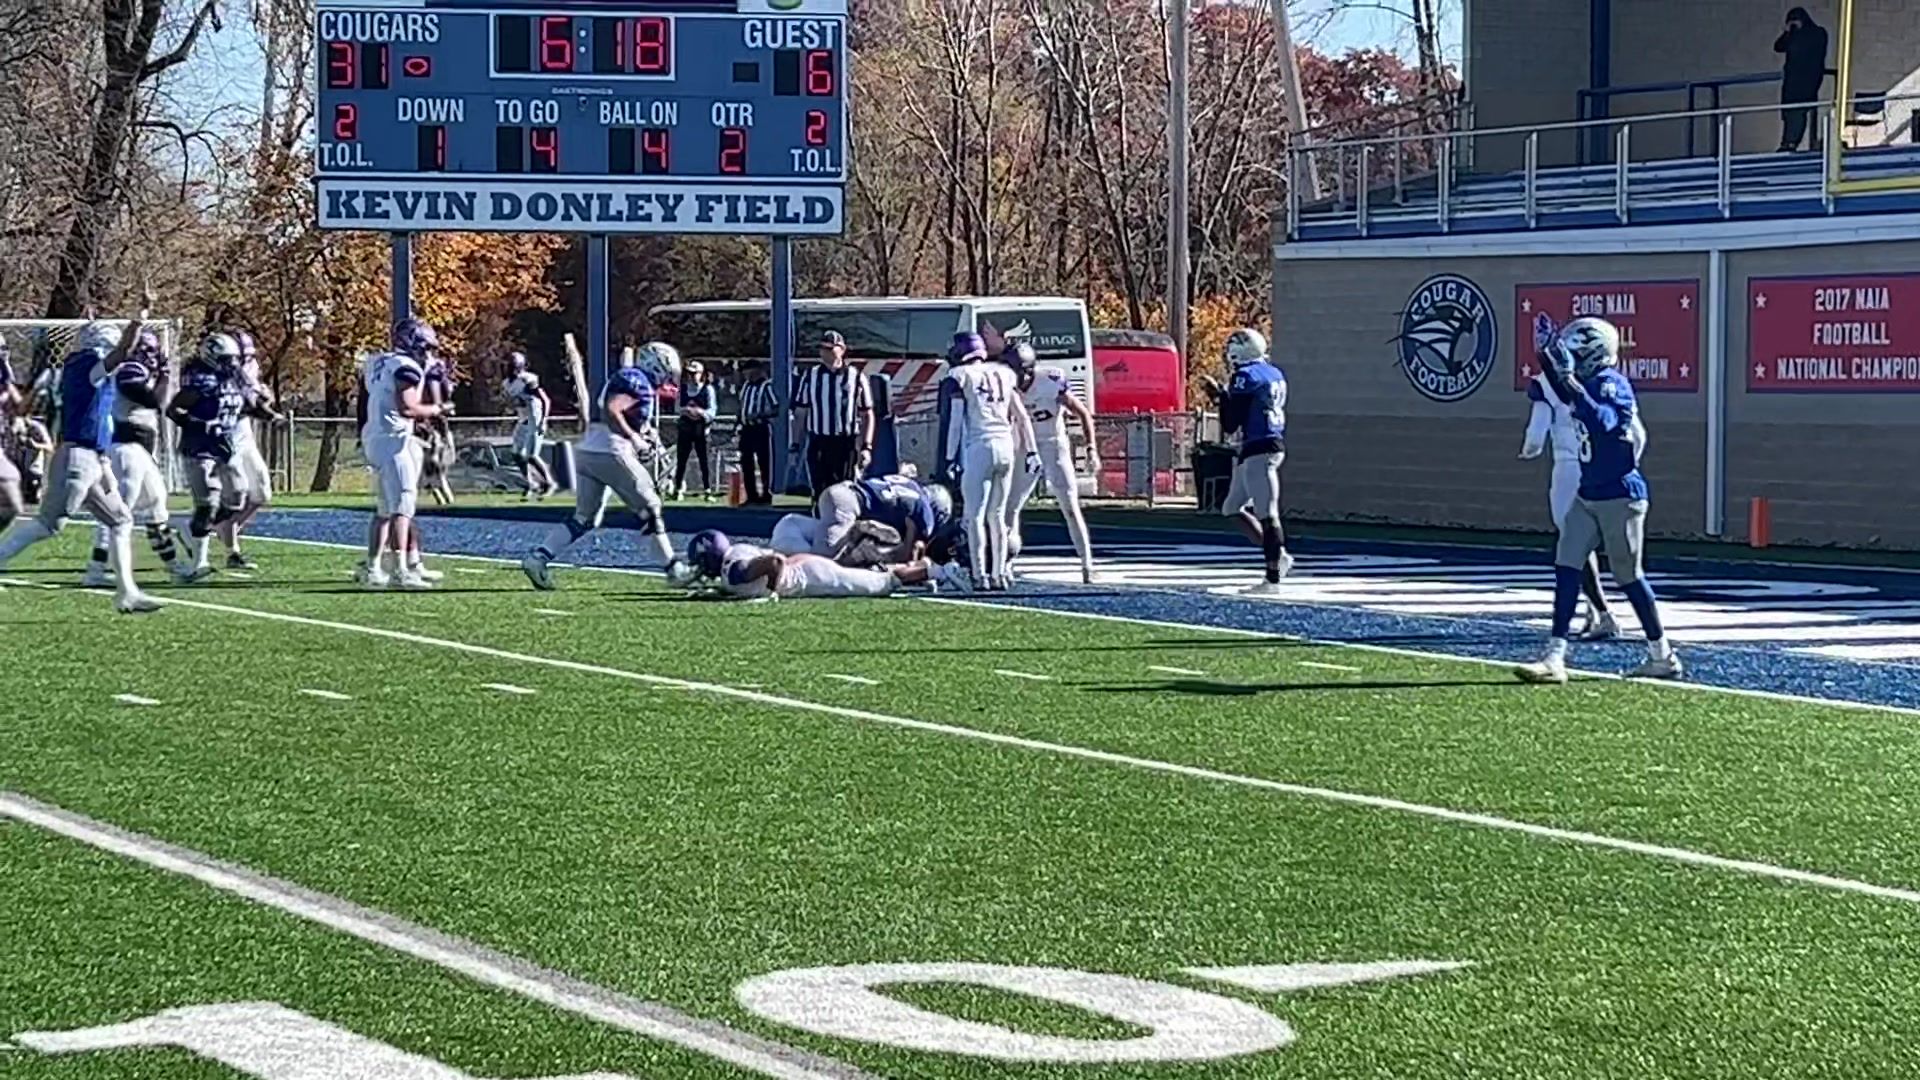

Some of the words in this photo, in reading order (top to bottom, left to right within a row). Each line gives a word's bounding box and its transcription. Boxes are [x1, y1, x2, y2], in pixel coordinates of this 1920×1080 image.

[320, 12, 440, 42] COUGARS
[743, 19, 838, 48] GUEST
[541, 17, 665, 69] 6:18
[330, 43, 386, 86] 31
[808, 51, 832, 94] 6
[336, 104, 355, 137] 2
[397, 97, 465, 123] DOWN
[495, 99, 523, 123] TO
[529, 99, 560, 123] GO
[600, 100, 646, 125] BALL
[651, 101, 678, 126] ON
[711, 101, 753, 127] QTR
[806, 110, 825, 144] 2
[320, 142, 373, 167] T.O.L.
[531, 130, 556, 167] 4
[643, 131, 667, 169] 4
[720, 129, 744, 172] 2
[789, 149, 842, 172] T.O.L.
[325, 189, 477, 221] KEVIN
[489, 191, 685, 223] DONLEY
[695, 194, 835, 224] FIELD
[1409, 282, 1486, 325] COUGAR
[1571, 294, 1604, 316] 2016
[1605, 292, 1636, 315] NAIA
[1814, 288, 1851, 312] 2017
[1854, 287, 1891, 311] NAIA
[1812, 322, 1891, 345] FOOTBALL
[1408, 353, 1485, 394] FOOTBALL
[1617, 357, 1669, 380] AMPION
[1776, 357, 1848, 380] NATIONAL
[1851, 356, 1920, 380] CHAMPIO
